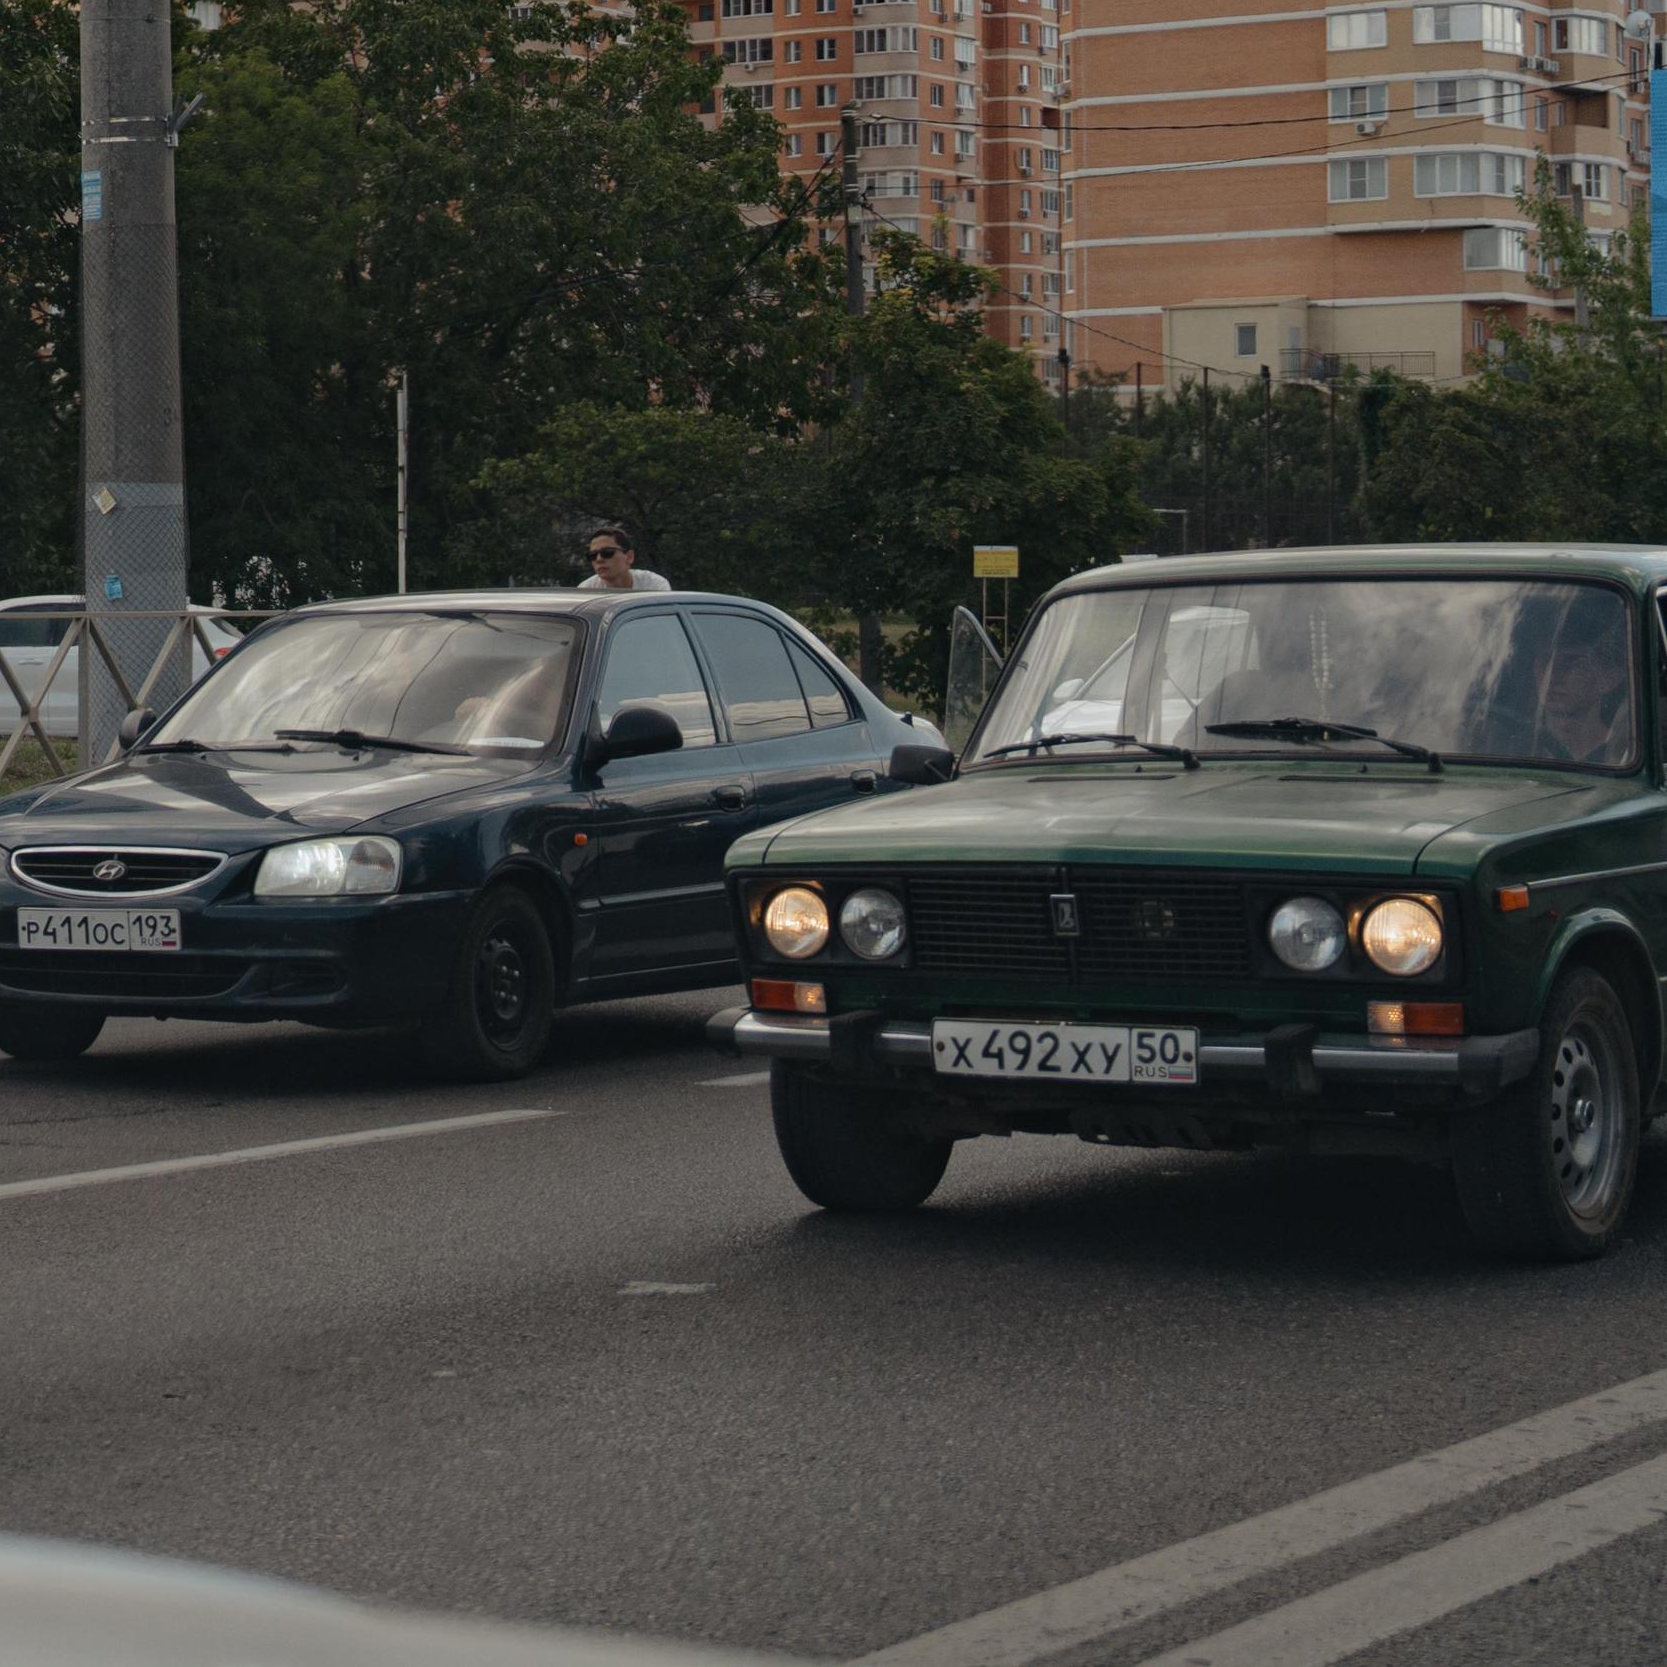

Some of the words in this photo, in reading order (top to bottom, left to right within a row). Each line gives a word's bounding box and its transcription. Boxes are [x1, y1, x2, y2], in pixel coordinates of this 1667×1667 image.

[26, 915, 126, 945] Р411ОС
[132, 915, 172, 937] 193
[140, 937, 161, 946] RUS
[951, 1029, 1121, 1074] Х492ХУ
[1136, 1032, 1179, 1064] 50
[1134, 1065, 1167, 1078] RUS
